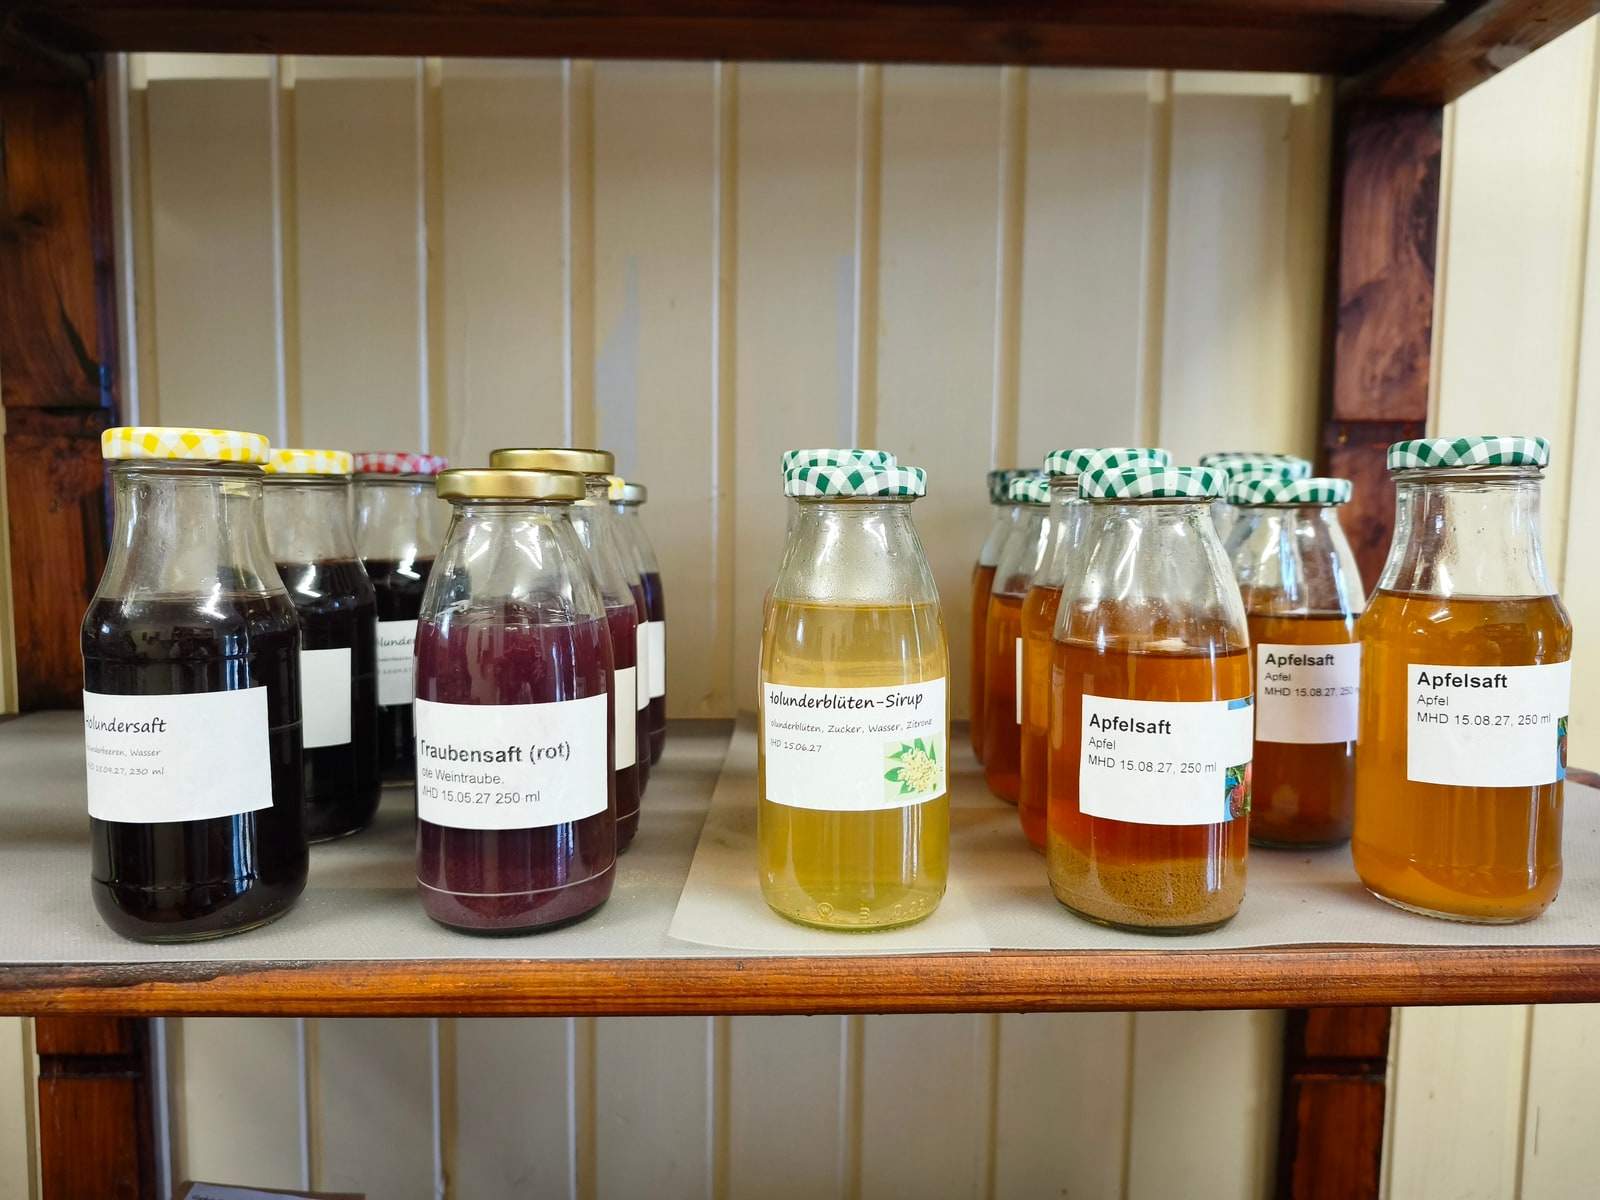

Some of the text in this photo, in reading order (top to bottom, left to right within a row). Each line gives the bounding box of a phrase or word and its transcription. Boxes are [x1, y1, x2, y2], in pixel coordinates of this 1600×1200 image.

[1265, 653, 1335, 667] Apfelsaft
[1264, 672, 1292, 682] Apfel
[1416, 671, 1508, 689] Apfelsaft
[1264, 686, 1291, 697] MHD
[1416, 695, 1449, 706] Apfel
[1088, 713, 1172, 735] Apfelsaft
[1416, 712, 1552, 727] MHD 15.08.27, 250 ml
[827, 724, 865, 734] Zucker,
[784, 741, 822, 752] 15.06.27
[1088, 736, 1116, 751] Apfel
[130, 748, 161, 757] Wasser
[530, 740, 570, 764] (rot)
[152, 767, 164, 776] ml
[1088, 754, 1217, 775] MHD 15.08.27, 250 ml
[435, 768, 504, 785] Weintraube.
[441, 789, 491, 804] 15.05.27
[495, 792, 520, 804] 250
[525, 790, 541, 803] ml
